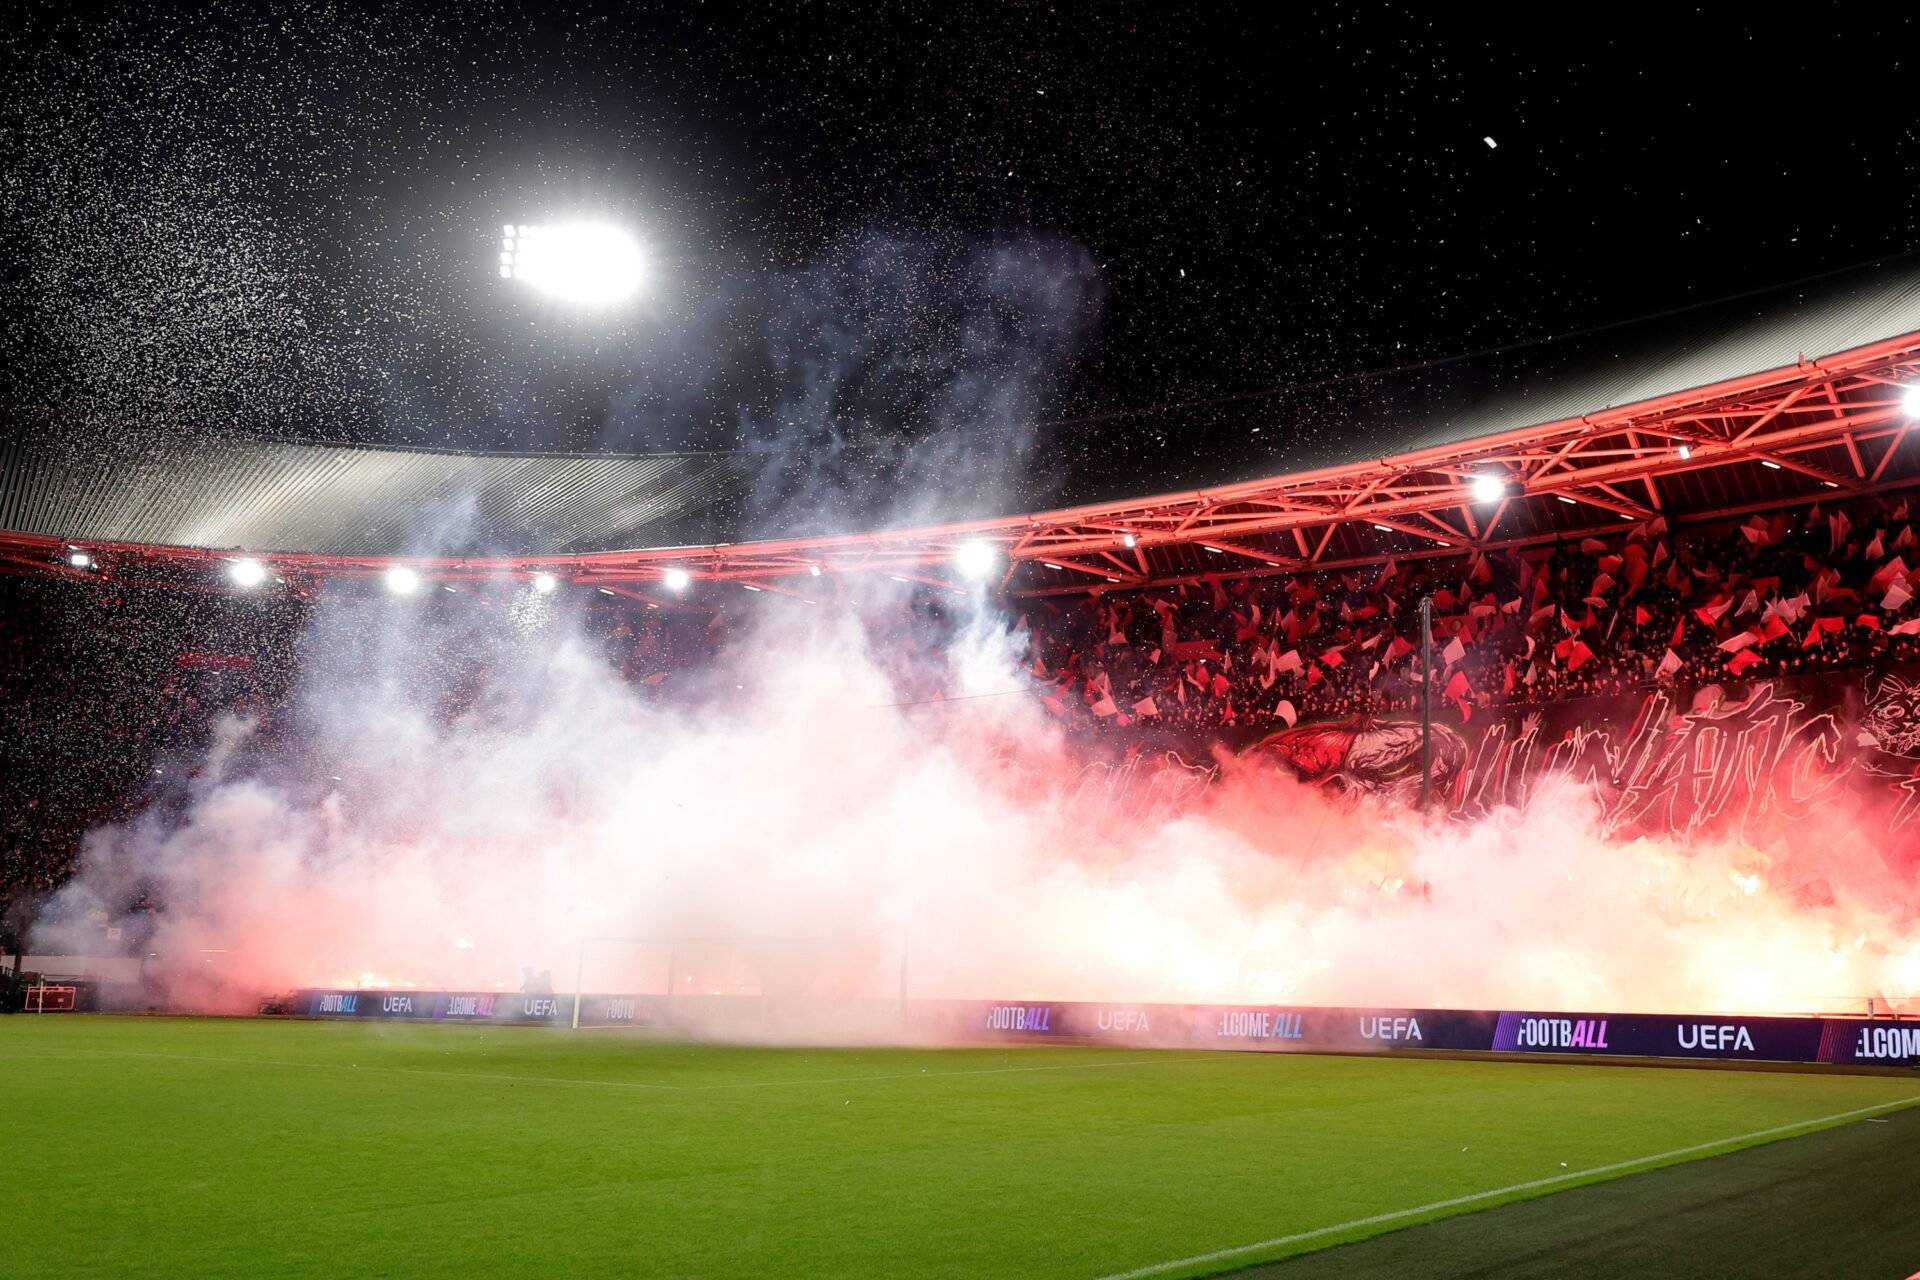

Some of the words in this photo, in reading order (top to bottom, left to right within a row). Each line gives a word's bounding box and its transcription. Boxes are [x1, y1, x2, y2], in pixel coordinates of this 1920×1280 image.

[383, 997, 412, 1012] UEFA
[524, 999, 558, 1016] UEFA
[1098, 1011, 1149, 1031] UEFA
[1272, 1014, 1302, 1040] ALL
[1360, 1016, 1423, 1041] UEFA
[1677, 1024, 1755, 1051] UEFA
